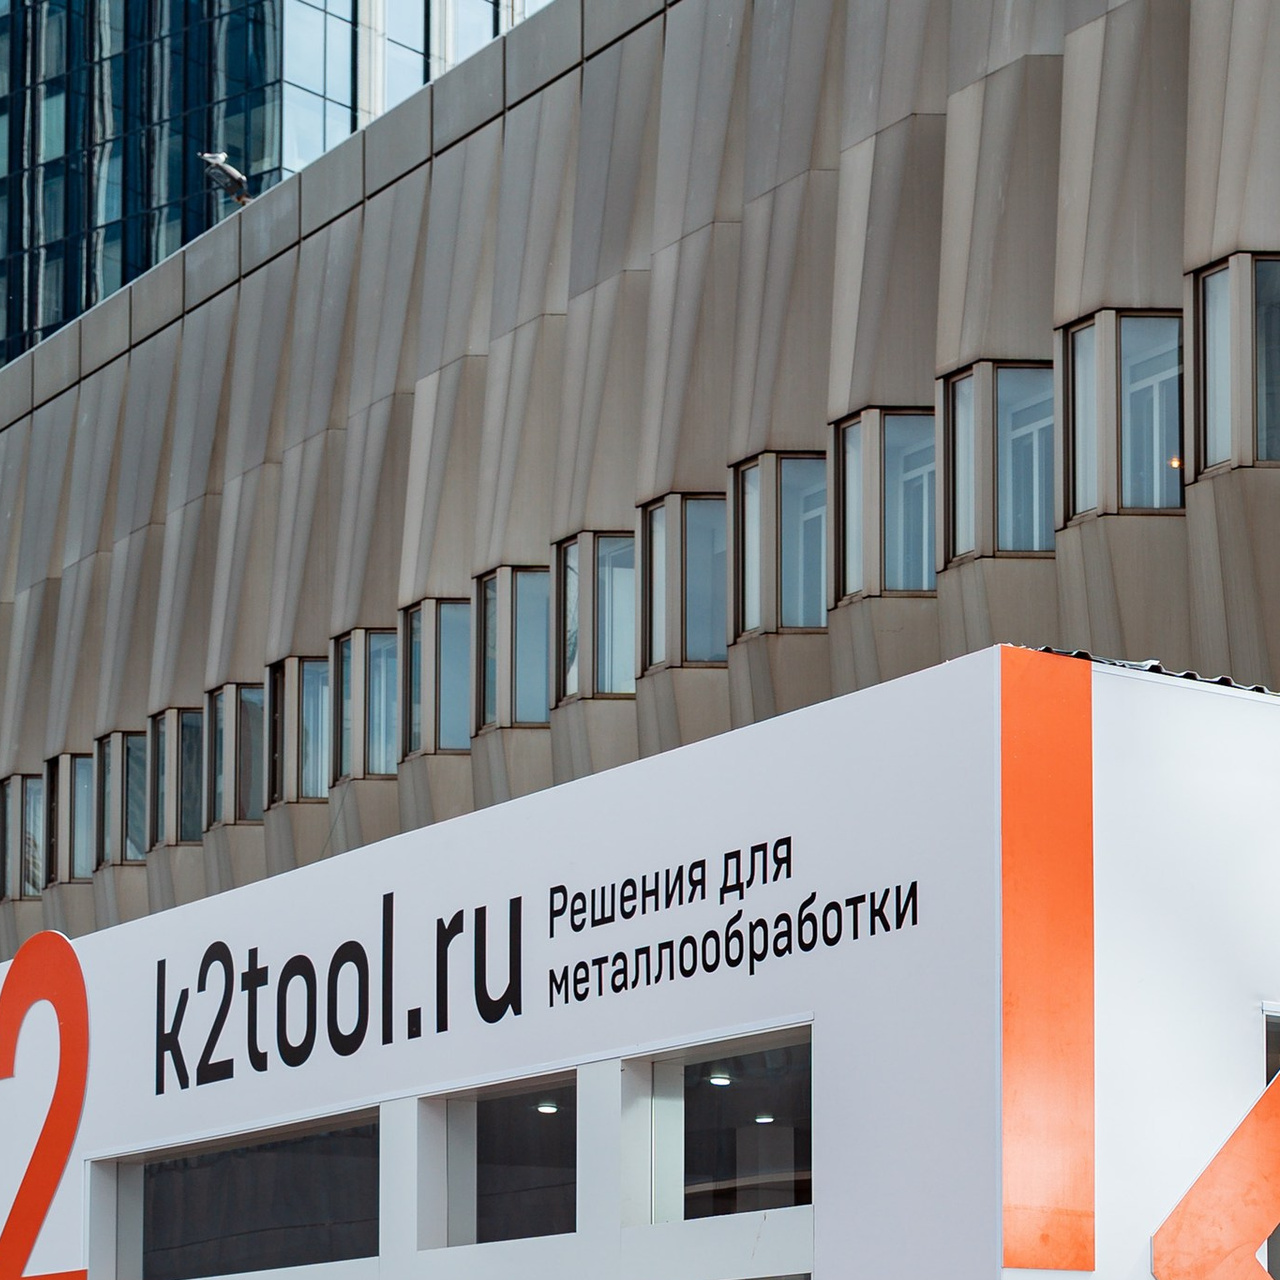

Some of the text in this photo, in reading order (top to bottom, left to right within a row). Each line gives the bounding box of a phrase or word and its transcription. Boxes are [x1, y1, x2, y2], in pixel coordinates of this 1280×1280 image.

[548, 836, 793, 939] Решения для
[548, 881, 919, 1008] металлообработки
[155, 892, 523, 1096] k2tool.ru
